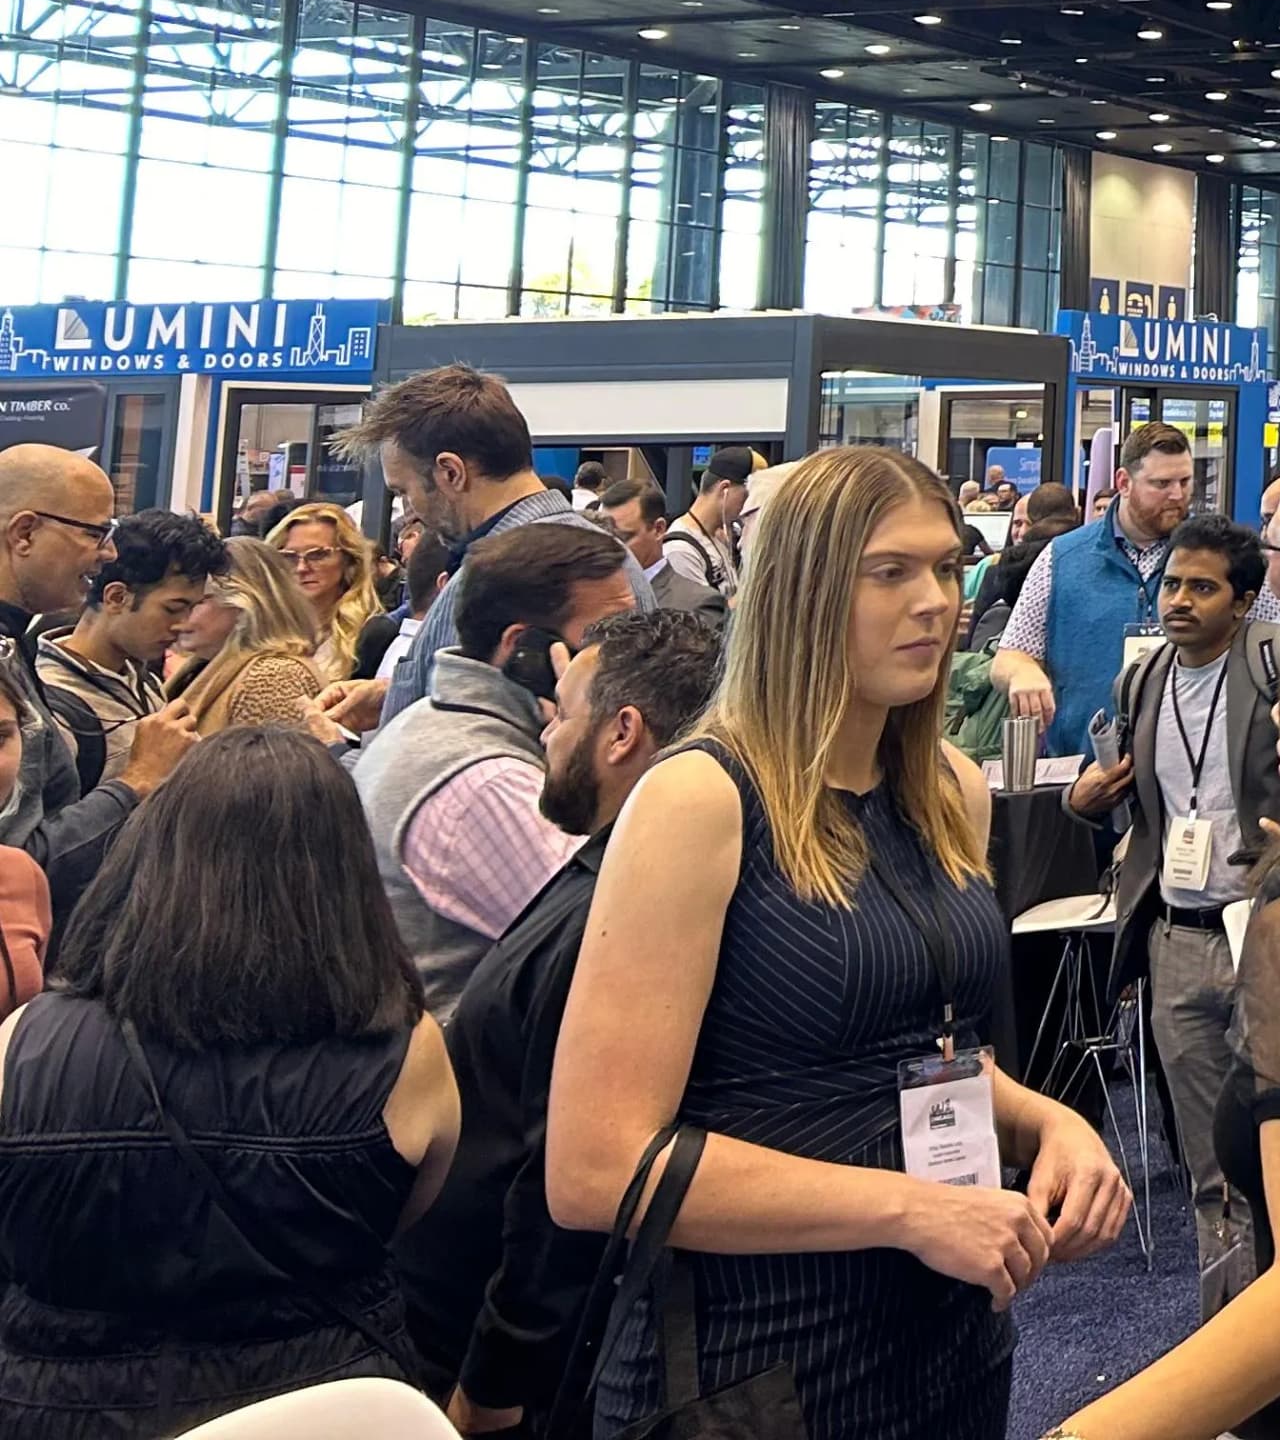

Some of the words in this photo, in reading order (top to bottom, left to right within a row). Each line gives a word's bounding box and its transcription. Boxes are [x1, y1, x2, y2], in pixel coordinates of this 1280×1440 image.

[55, 303, 286, 351] LUMINI
[1119, 319, 1230, 365] LUMINI
[53, 352, 165, 372] WINDOWS
[177, 354, 190, 370] &
[204, 351, 283, 369] DOORS
[1118, 362, 1175, 378] WINDOWS
[1193, 367, 1229, 381] DOORS
[10, 400, 52, 412] TIMBER
